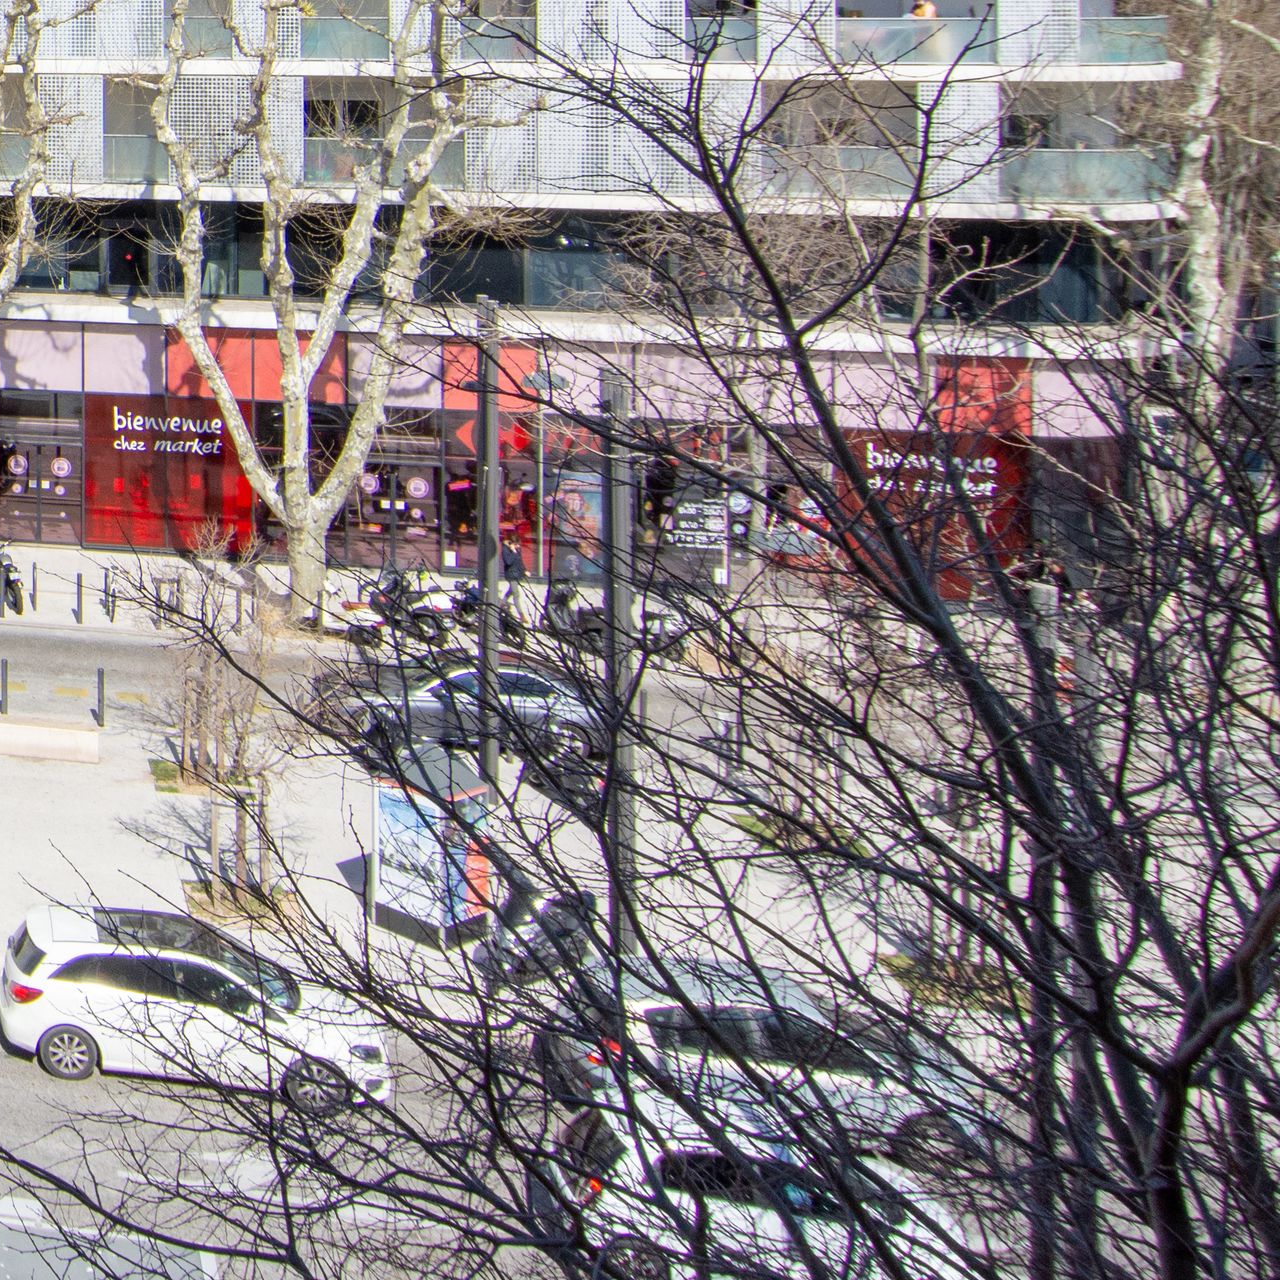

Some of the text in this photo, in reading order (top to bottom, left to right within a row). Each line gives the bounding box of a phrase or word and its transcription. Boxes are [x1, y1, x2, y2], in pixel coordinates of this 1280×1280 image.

[113, 405, 222, 435] bienvenue
[113, 434, 222, 456] chez market
